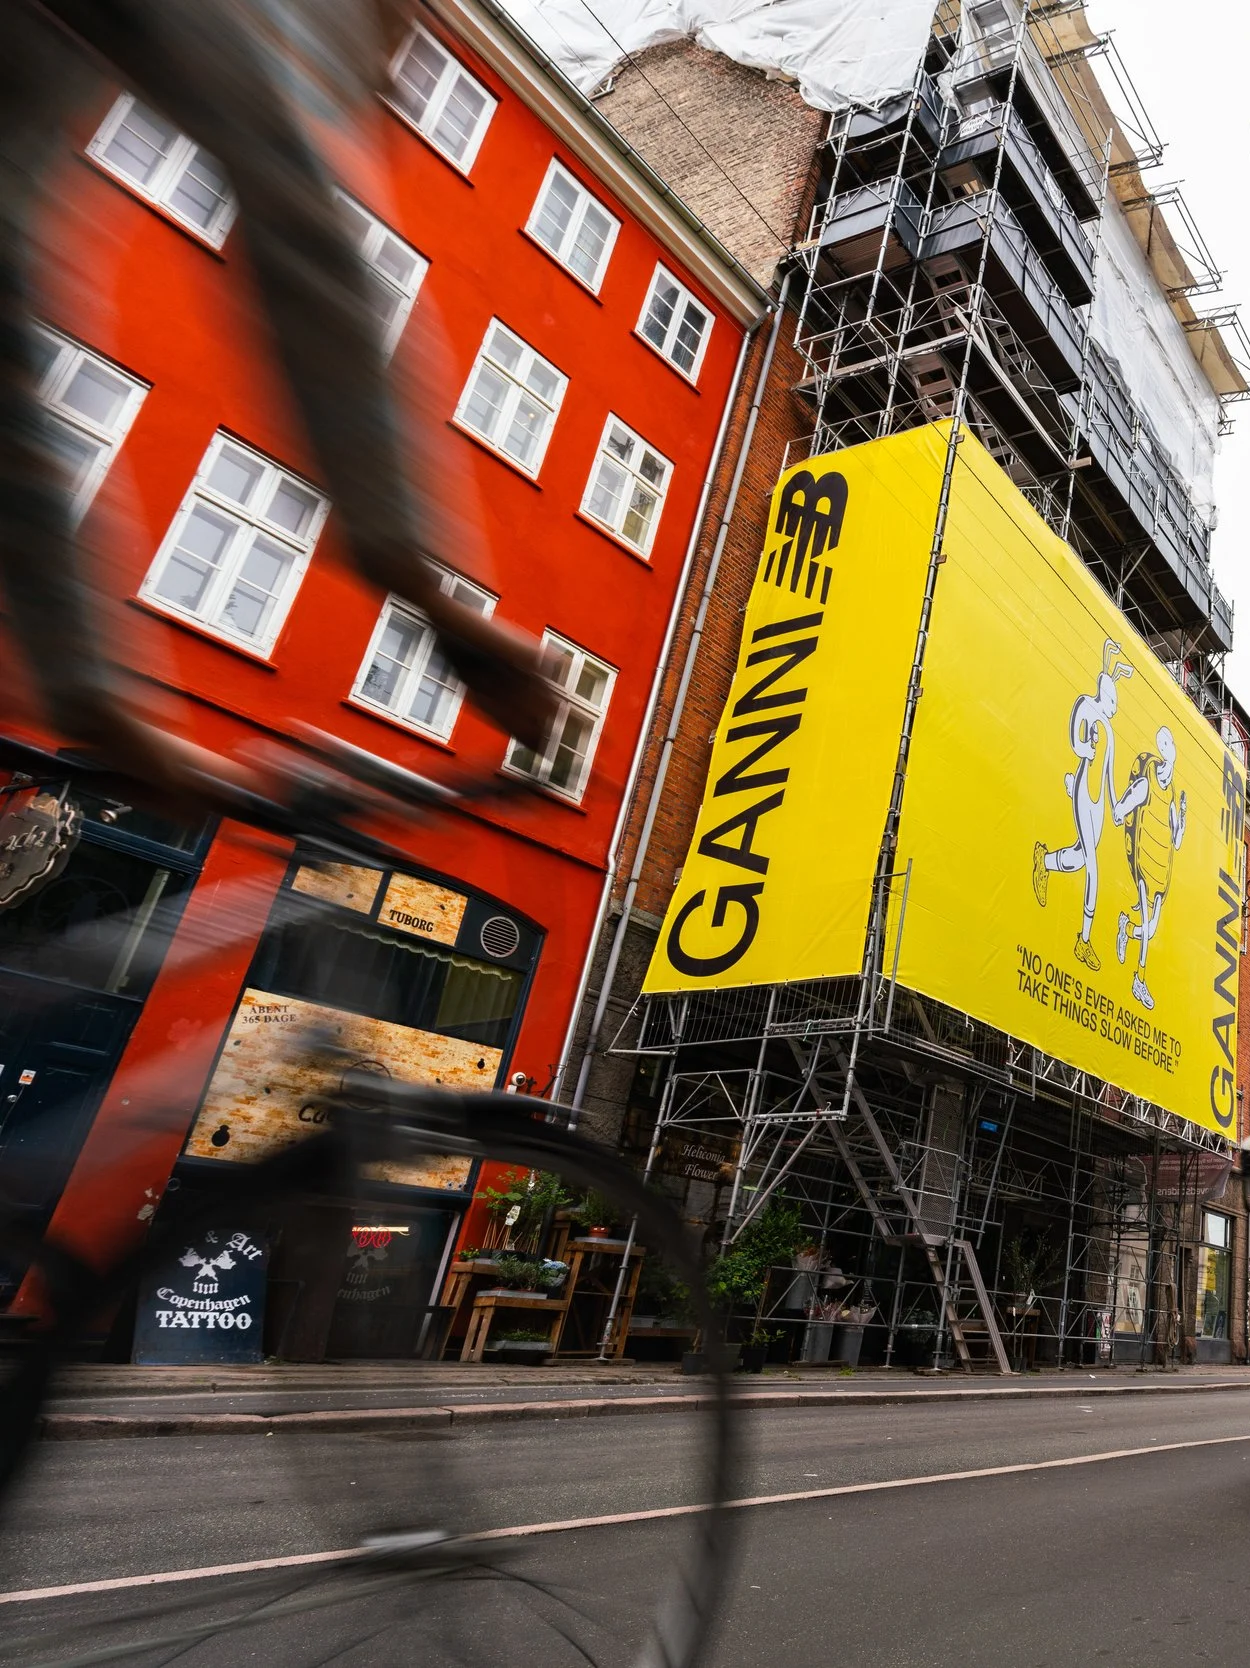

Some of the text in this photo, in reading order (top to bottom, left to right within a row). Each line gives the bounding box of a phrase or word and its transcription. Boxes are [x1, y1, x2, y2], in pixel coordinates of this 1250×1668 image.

[666, 611, 824, 977] GANNI
[389, 909, 435, 933] TUBORG
[1017, 969, 1050, 1007] TAKE
[1052, 990, 1098, 1032] THINGS
[1100, 1018, 1132, 1051] SLOW
[1210, 867, 1240, 1129] GANNI
[242, 1014, 297, 1024] 365 DAGE
[1085, 986, 1114, 1019] EVER
[1116, 1006, 1151, 1040] ASKED
[1153, 1027, 1167, 1050] ME
[1169, 1036, 1182, 1058] TO
[684, 1163, 720, 1180] Flower
[225, 1232, 263, 1261] Art
[156, 1286, 251, 1312] Copenhagen
[155, 1310, 253, 1330] TATTOO
